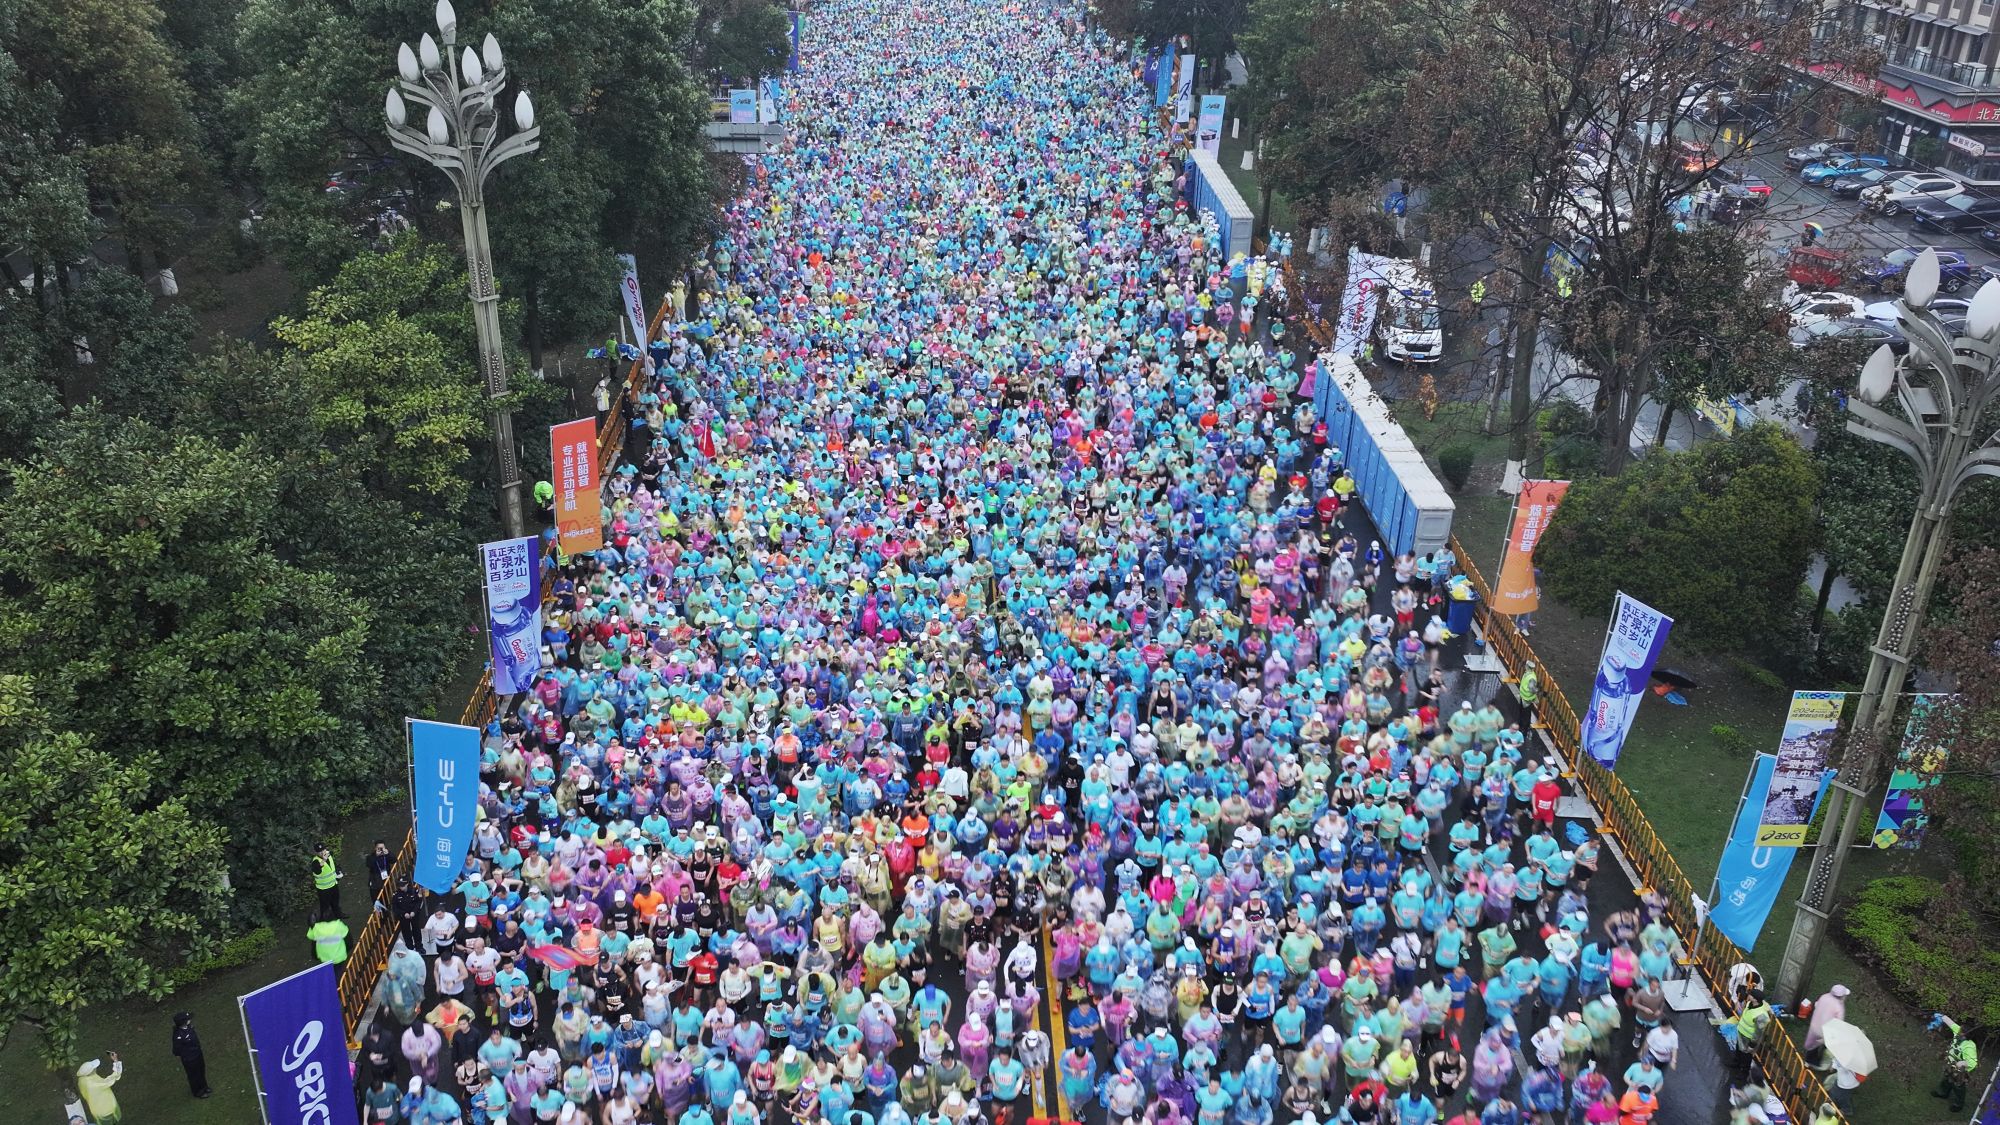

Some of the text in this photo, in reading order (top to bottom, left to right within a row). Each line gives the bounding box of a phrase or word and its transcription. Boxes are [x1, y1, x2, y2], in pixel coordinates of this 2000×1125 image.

[576, 441, 589, 487] 就选韶音
[562, 445, 577, 511] 专业运动耳机
[488, 544, 526, 558] 真正天然
[489, 554, 527, 570] 矿泉水
[490, 567, 527, 582] 百岁山
[1621, 610, 1653, 638] 矿泉水
[1623, 601, 1658, 627] 真正天然
[1618, 623, 1649, 650] 百岁山
[436, 758, 455, 868] BYD 海豹
[1774, 831, 1801, 840] asics
